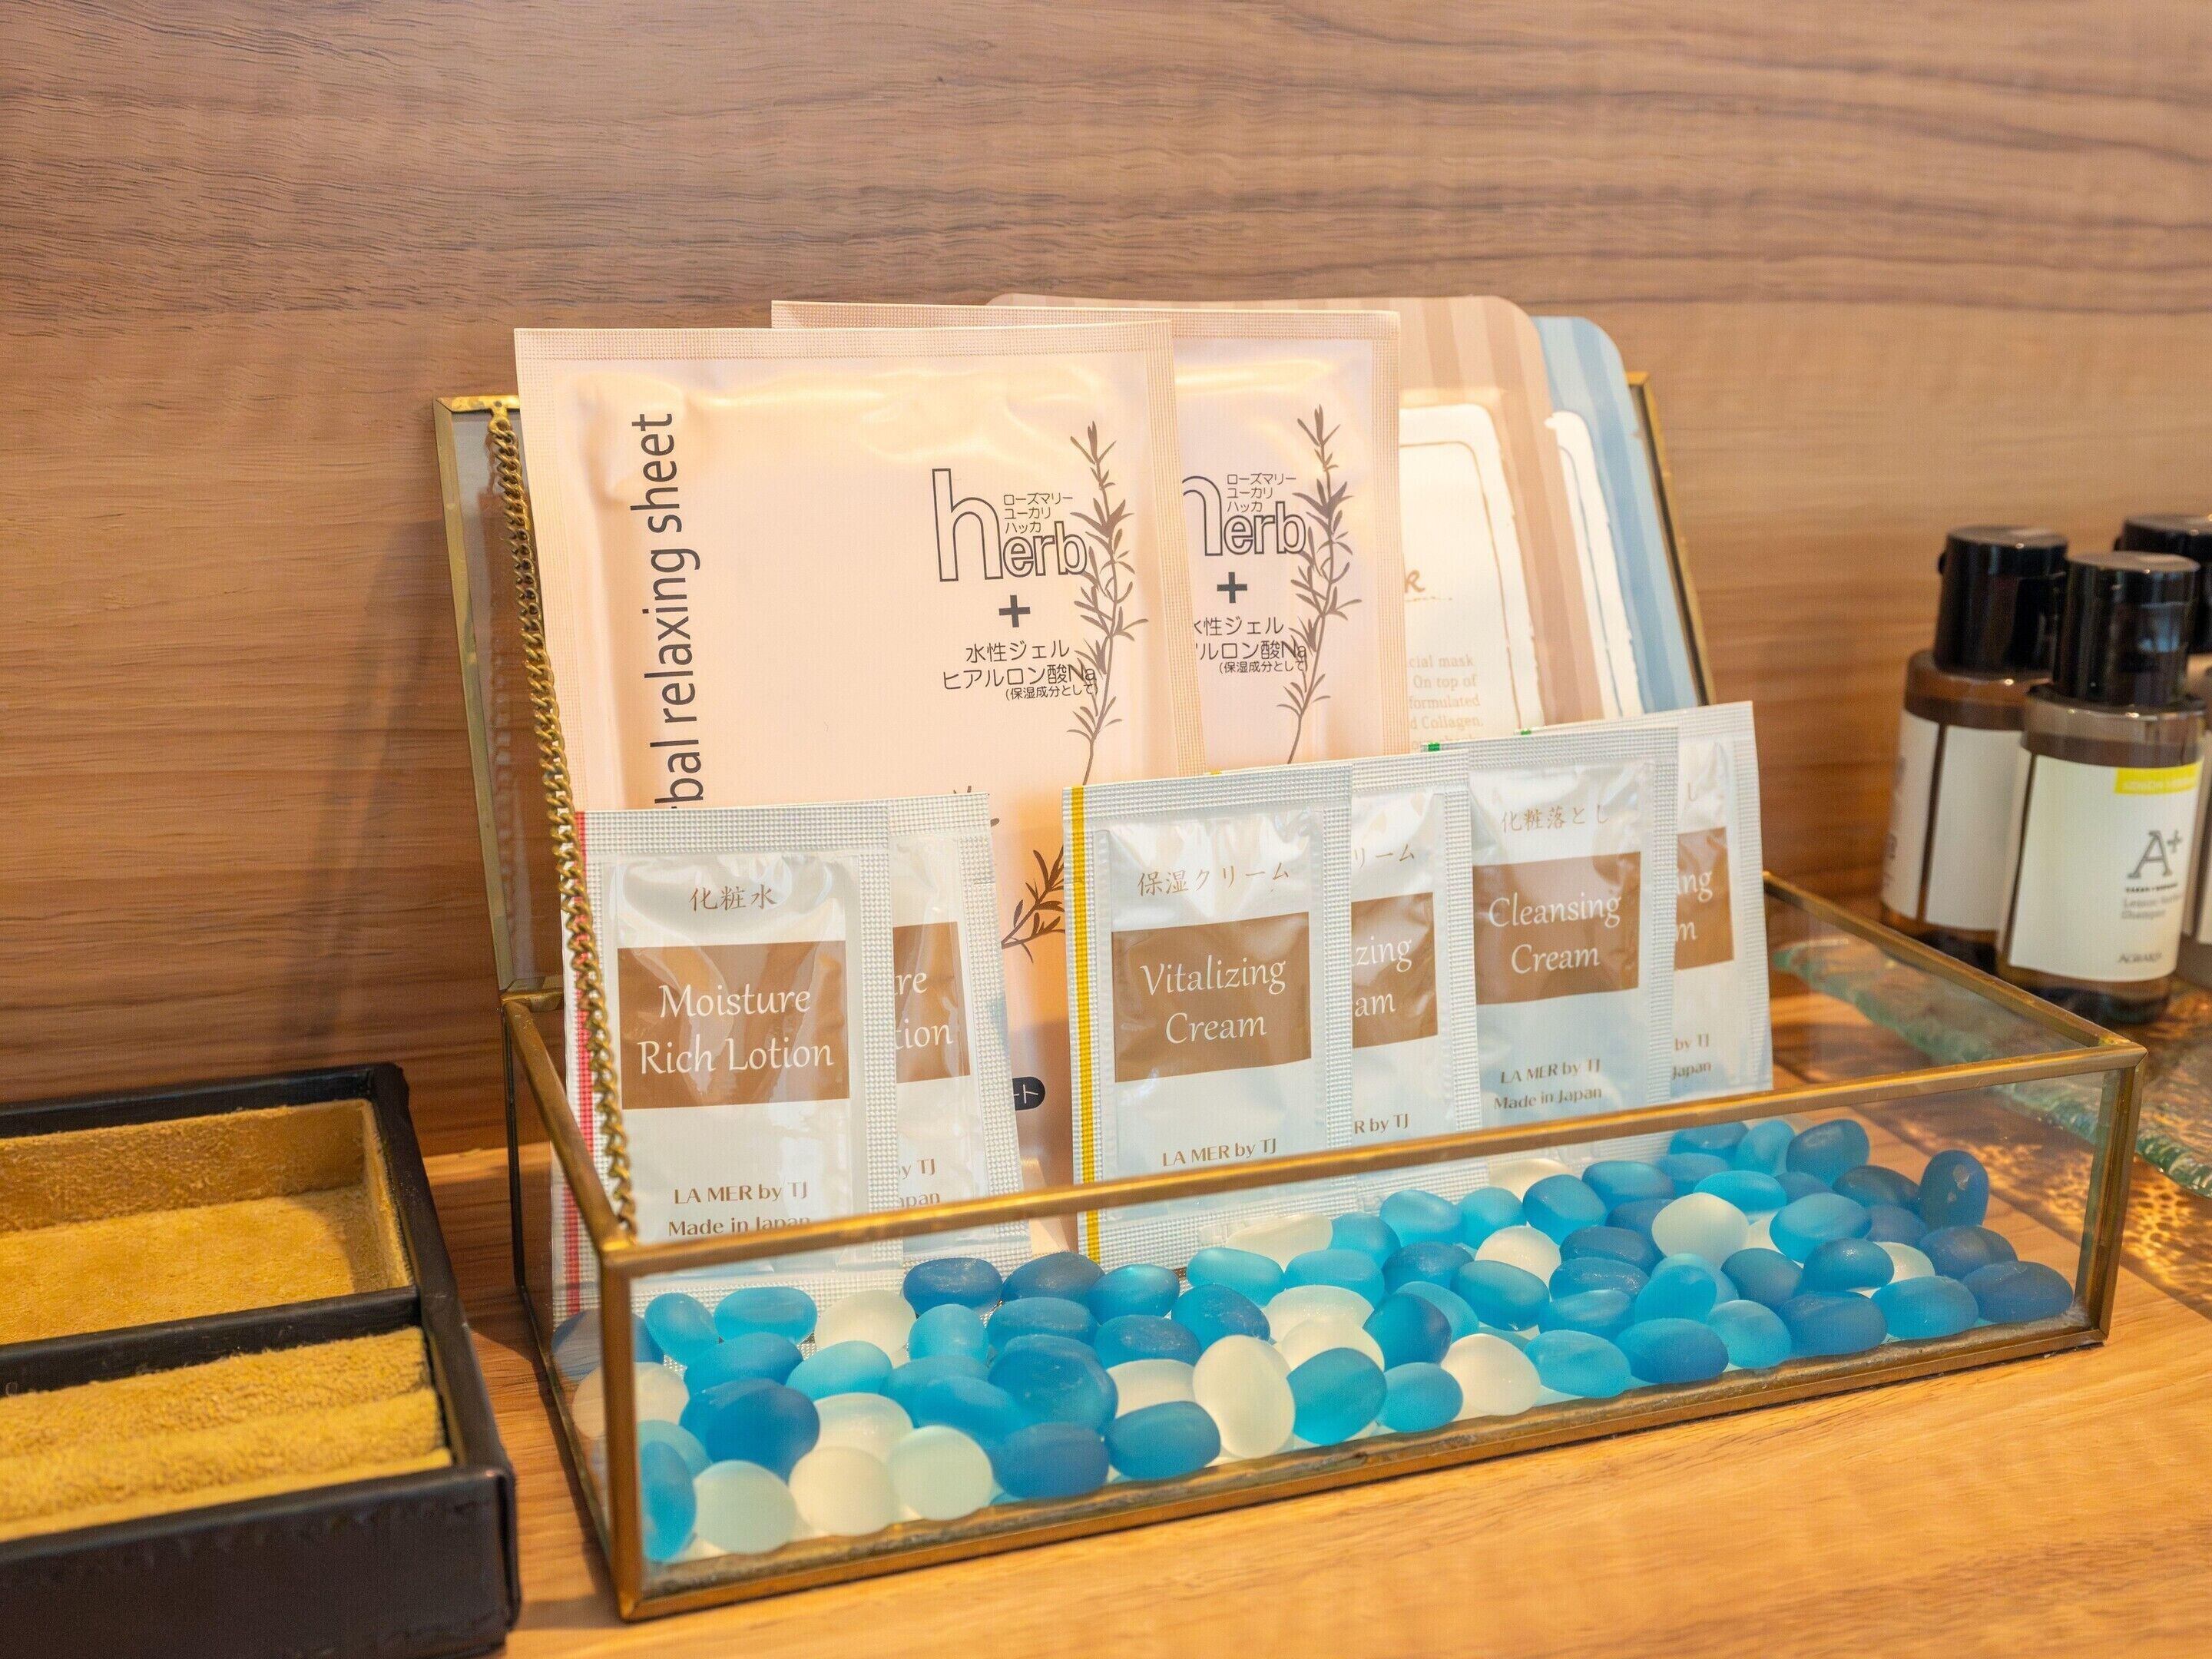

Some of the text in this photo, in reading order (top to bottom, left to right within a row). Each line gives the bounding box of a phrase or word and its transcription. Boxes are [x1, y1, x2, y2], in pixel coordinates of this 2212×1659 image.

[1227, 472, 1296, 485] ローズマリー
[1003, 492, 1074, 505] ローズマリー
[1227, 487, 1273, 499] ユーカリ
[1004, 506, 1051, 520] ユーカリ
[1227, 501, 1263, 513] ハッカ
[932, 468, 1088, 582] herb
[1005, 521, 1042, 534] ハッカ
[631, 414, 704, 809] bal relaxing sheet
[965, 639, 1070, 663] 水性ジェル
[1195, 640, 1307, 661] ルロン酸Na
[943, 663, 1098, 690] ヒアルロン酸Na
[1219, 660, 1308, 674] (保湿成分として)
[1005, 683, 1098, 700] (保湿成分として)
[1412, 674, 1432, 689] On
[1435, 675, 1459, 691] top
[1502, 804, 1610, 833] 化粧落とし
[1138, 862, 1289, 897] 保湿クリーム
[689, 884, 777, 912] 化粧水
[1488, 892, 1622, 929] Cleansing
[1351, 935, 1412, 973] zing
[1512, 943, 1601, 975] Cream
[894, 972, 928, 996] re
[1140, 955, 1286, 995] Vitalizing
[658, 983, 811, 1018] Moisture
[1352, 993, 1396, 1018] am
[1166, 1012, 1267, 1045] Cream
[637, 1034, 835, 1075] Rich Lotion
[1675, 1038, 1692, 1052] by
[1500, 1070, 1522, 1084] LA
[1526, 1063, 1558, 1079] MER
[1562, 1061, 1581, 1077] by
[1494, 1087, 1602, 1110] Made in Japan
[1354, 1114, 1409, 1134] R by TJ
[1162, 1137, 1277, 1167] LA MER by TJ
[916, 1158, 936, 1175] TJ
[674, 1181, 807, 1204] LA MER by TJ
[668, 1219, 724, 1237] Made
[730, 1217, 748, 1233] in
